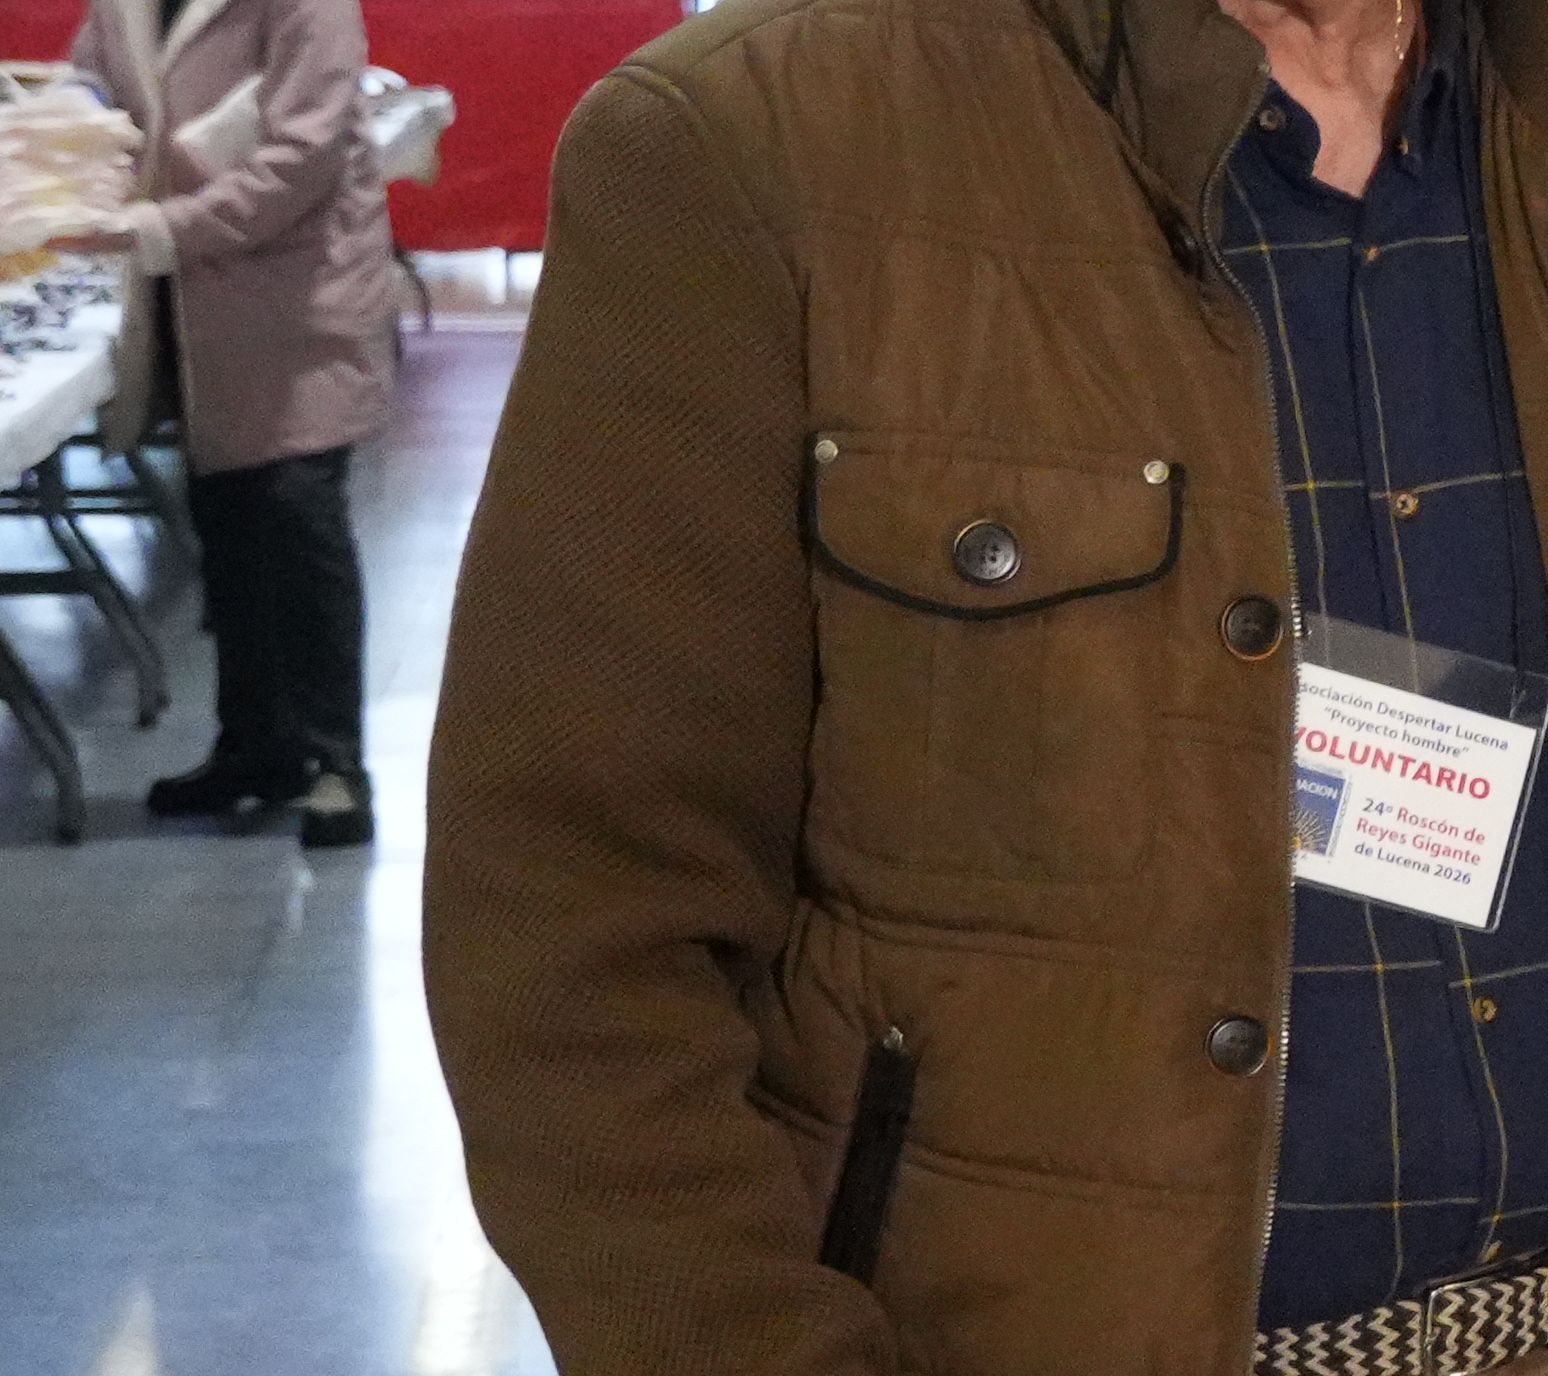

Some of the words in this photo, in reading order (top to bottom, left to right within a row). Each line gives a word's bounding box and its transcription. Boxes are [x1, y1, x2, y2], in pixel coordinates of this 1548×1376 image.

[1299, 682, 1374, 713] sociación
[1376, 701, 1452, 734] Despertar
[1455, 724, 1510, 752] Lucena
[1356, 817, 1407, 844] Reyes
[1412, 834, 1481, 866] Gigante
[1396, 807, 1460, 839] Roscón
[1463, 827, 1486, 845] de
[1353, 841, 1374, 857] de
[1376, 847, 1431, 874] Lucena
[1433, 863, 1472, 886] 2026
